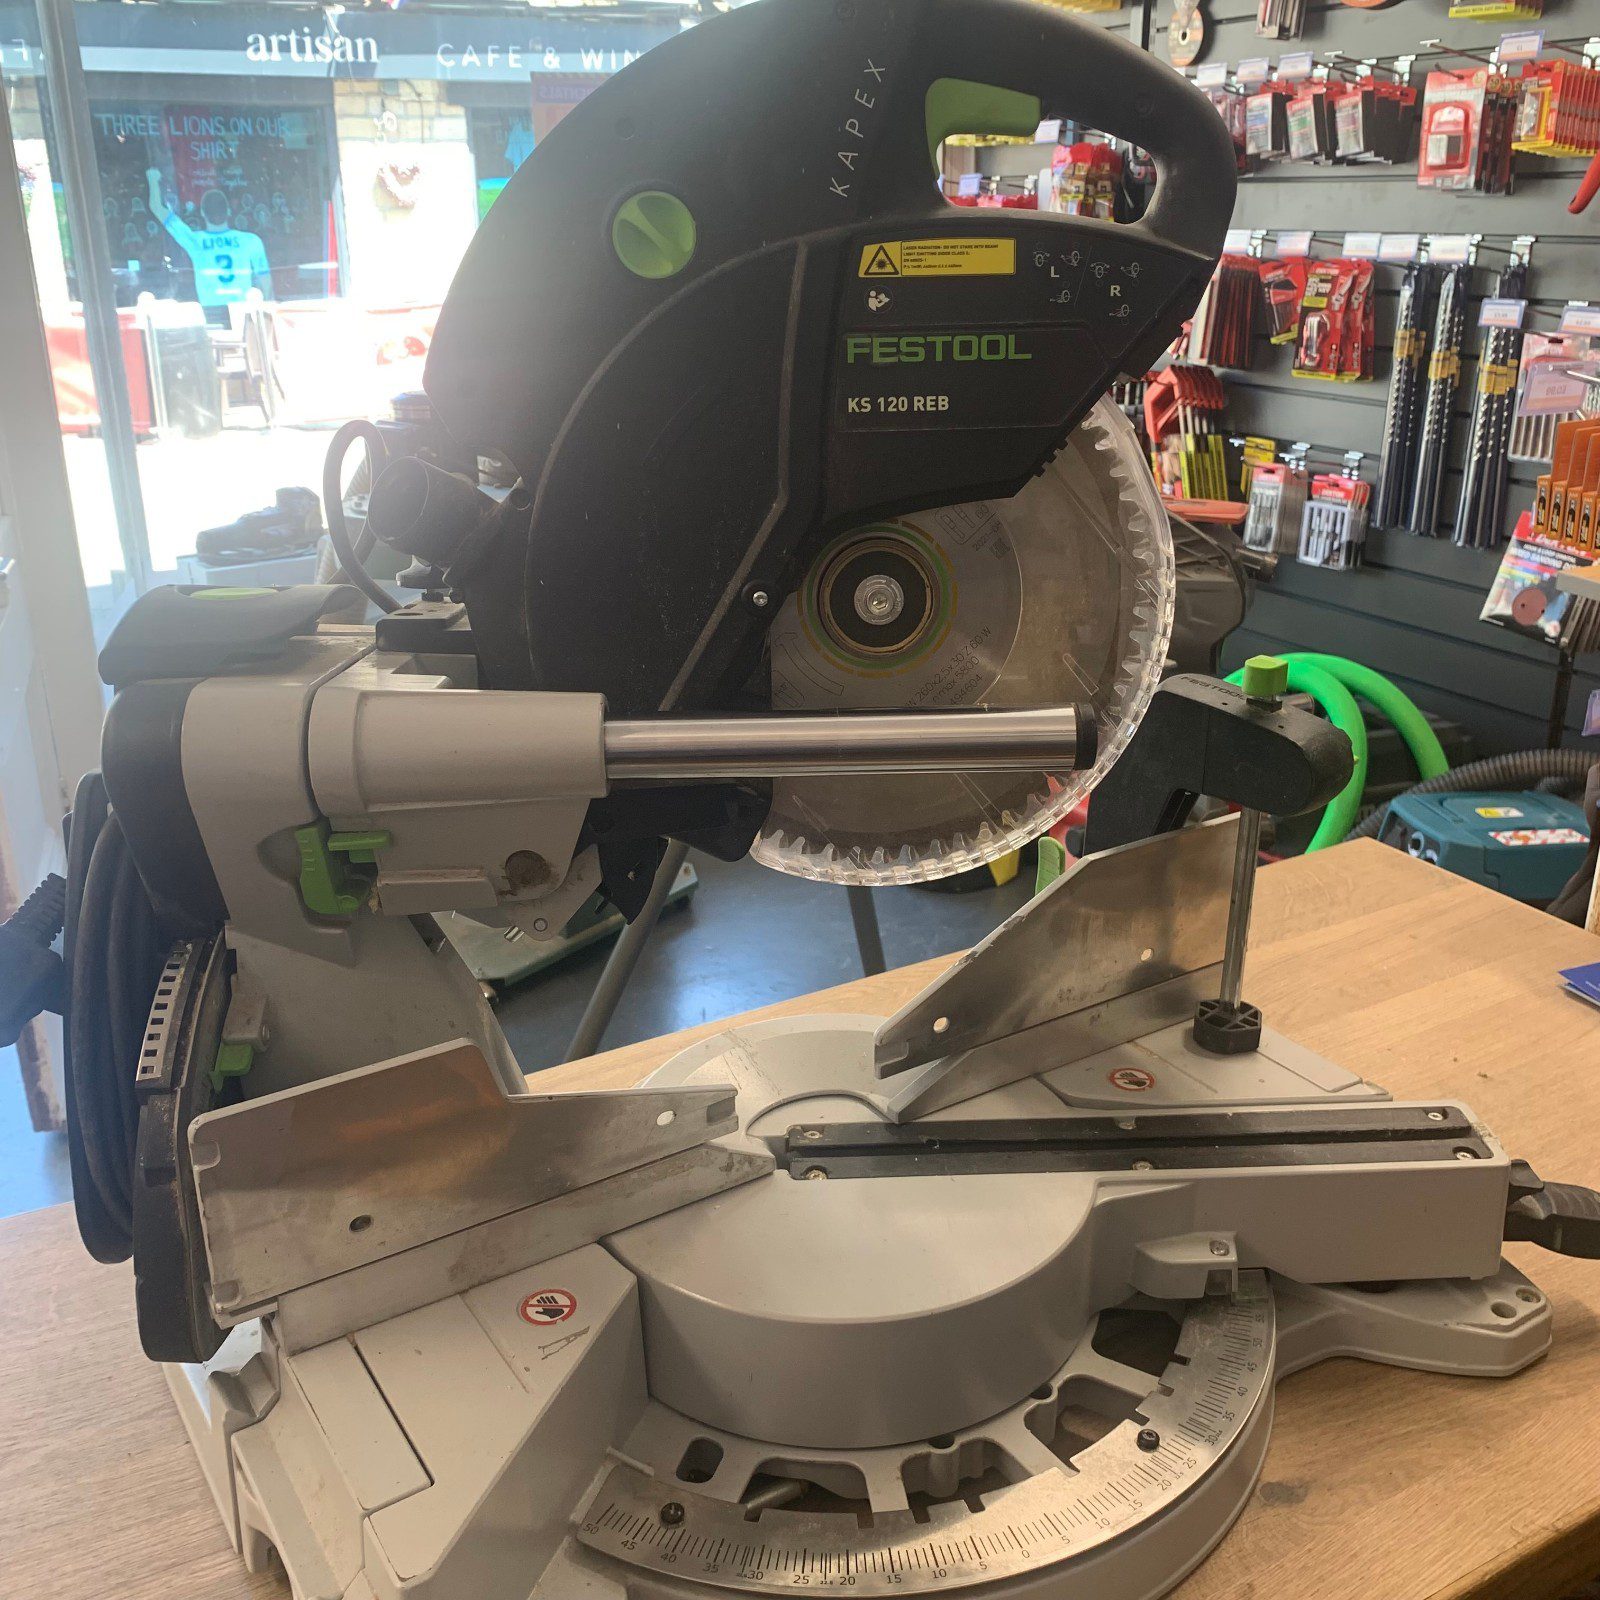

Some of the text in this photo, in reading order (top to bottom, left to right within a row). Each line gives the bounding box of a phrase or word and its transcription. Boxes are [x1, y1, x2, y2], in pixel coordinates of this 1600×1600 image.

[246, 26, 380, 64] artisan
[436, 43, 522, 68] CAFE
[543, 46, 561, 69] &
[94, 112, 291, 137] THREE LIONS ON OUR
[829, 58, 886, 198] KAPEX
[190, 140, 239, 161] SHIRT
[202, 236, 240, 250] LIONS
[1050, 266, 1060, 278] L
[1110, 285, 1121, 297] R
[846, 334, 1033, 364] FESTOOL
[847, 395, 949, 413] KS 120 REB
[1247, 1362, 1259, 1373] 45
[1236, 1386, 1249, 1398] 40
[1222, 1411, 1236, 1423] 35
[1204, 1432, 1219, 1446] 30
[1182, 1457, 1197, 1469] 25
[1156, 1479, 1172, 1492] 20
[1128, 1499, 1143, 1512] 15
[582, 1522, 600, 1535] 50
[1095, 1517, 1111, 1530] 10
[620, 1539, 638, 1551] 45
[1061, 1536, 1071, 1545] 5
[660, 1551, 677, 1564] 40
[1021, 1550, 1031, 1559] 0
[702, 1563, 720, 1574] 35
[979, 1562, 988, 1570] 5
[748, 1571, 764, 1580] 30
[793, 1574, 810, 1584] 25
[886, 1574, 902, 1584] 15
[932, 1568, 947, 1579] 10
[839, 1576, 856, 1586] 20
